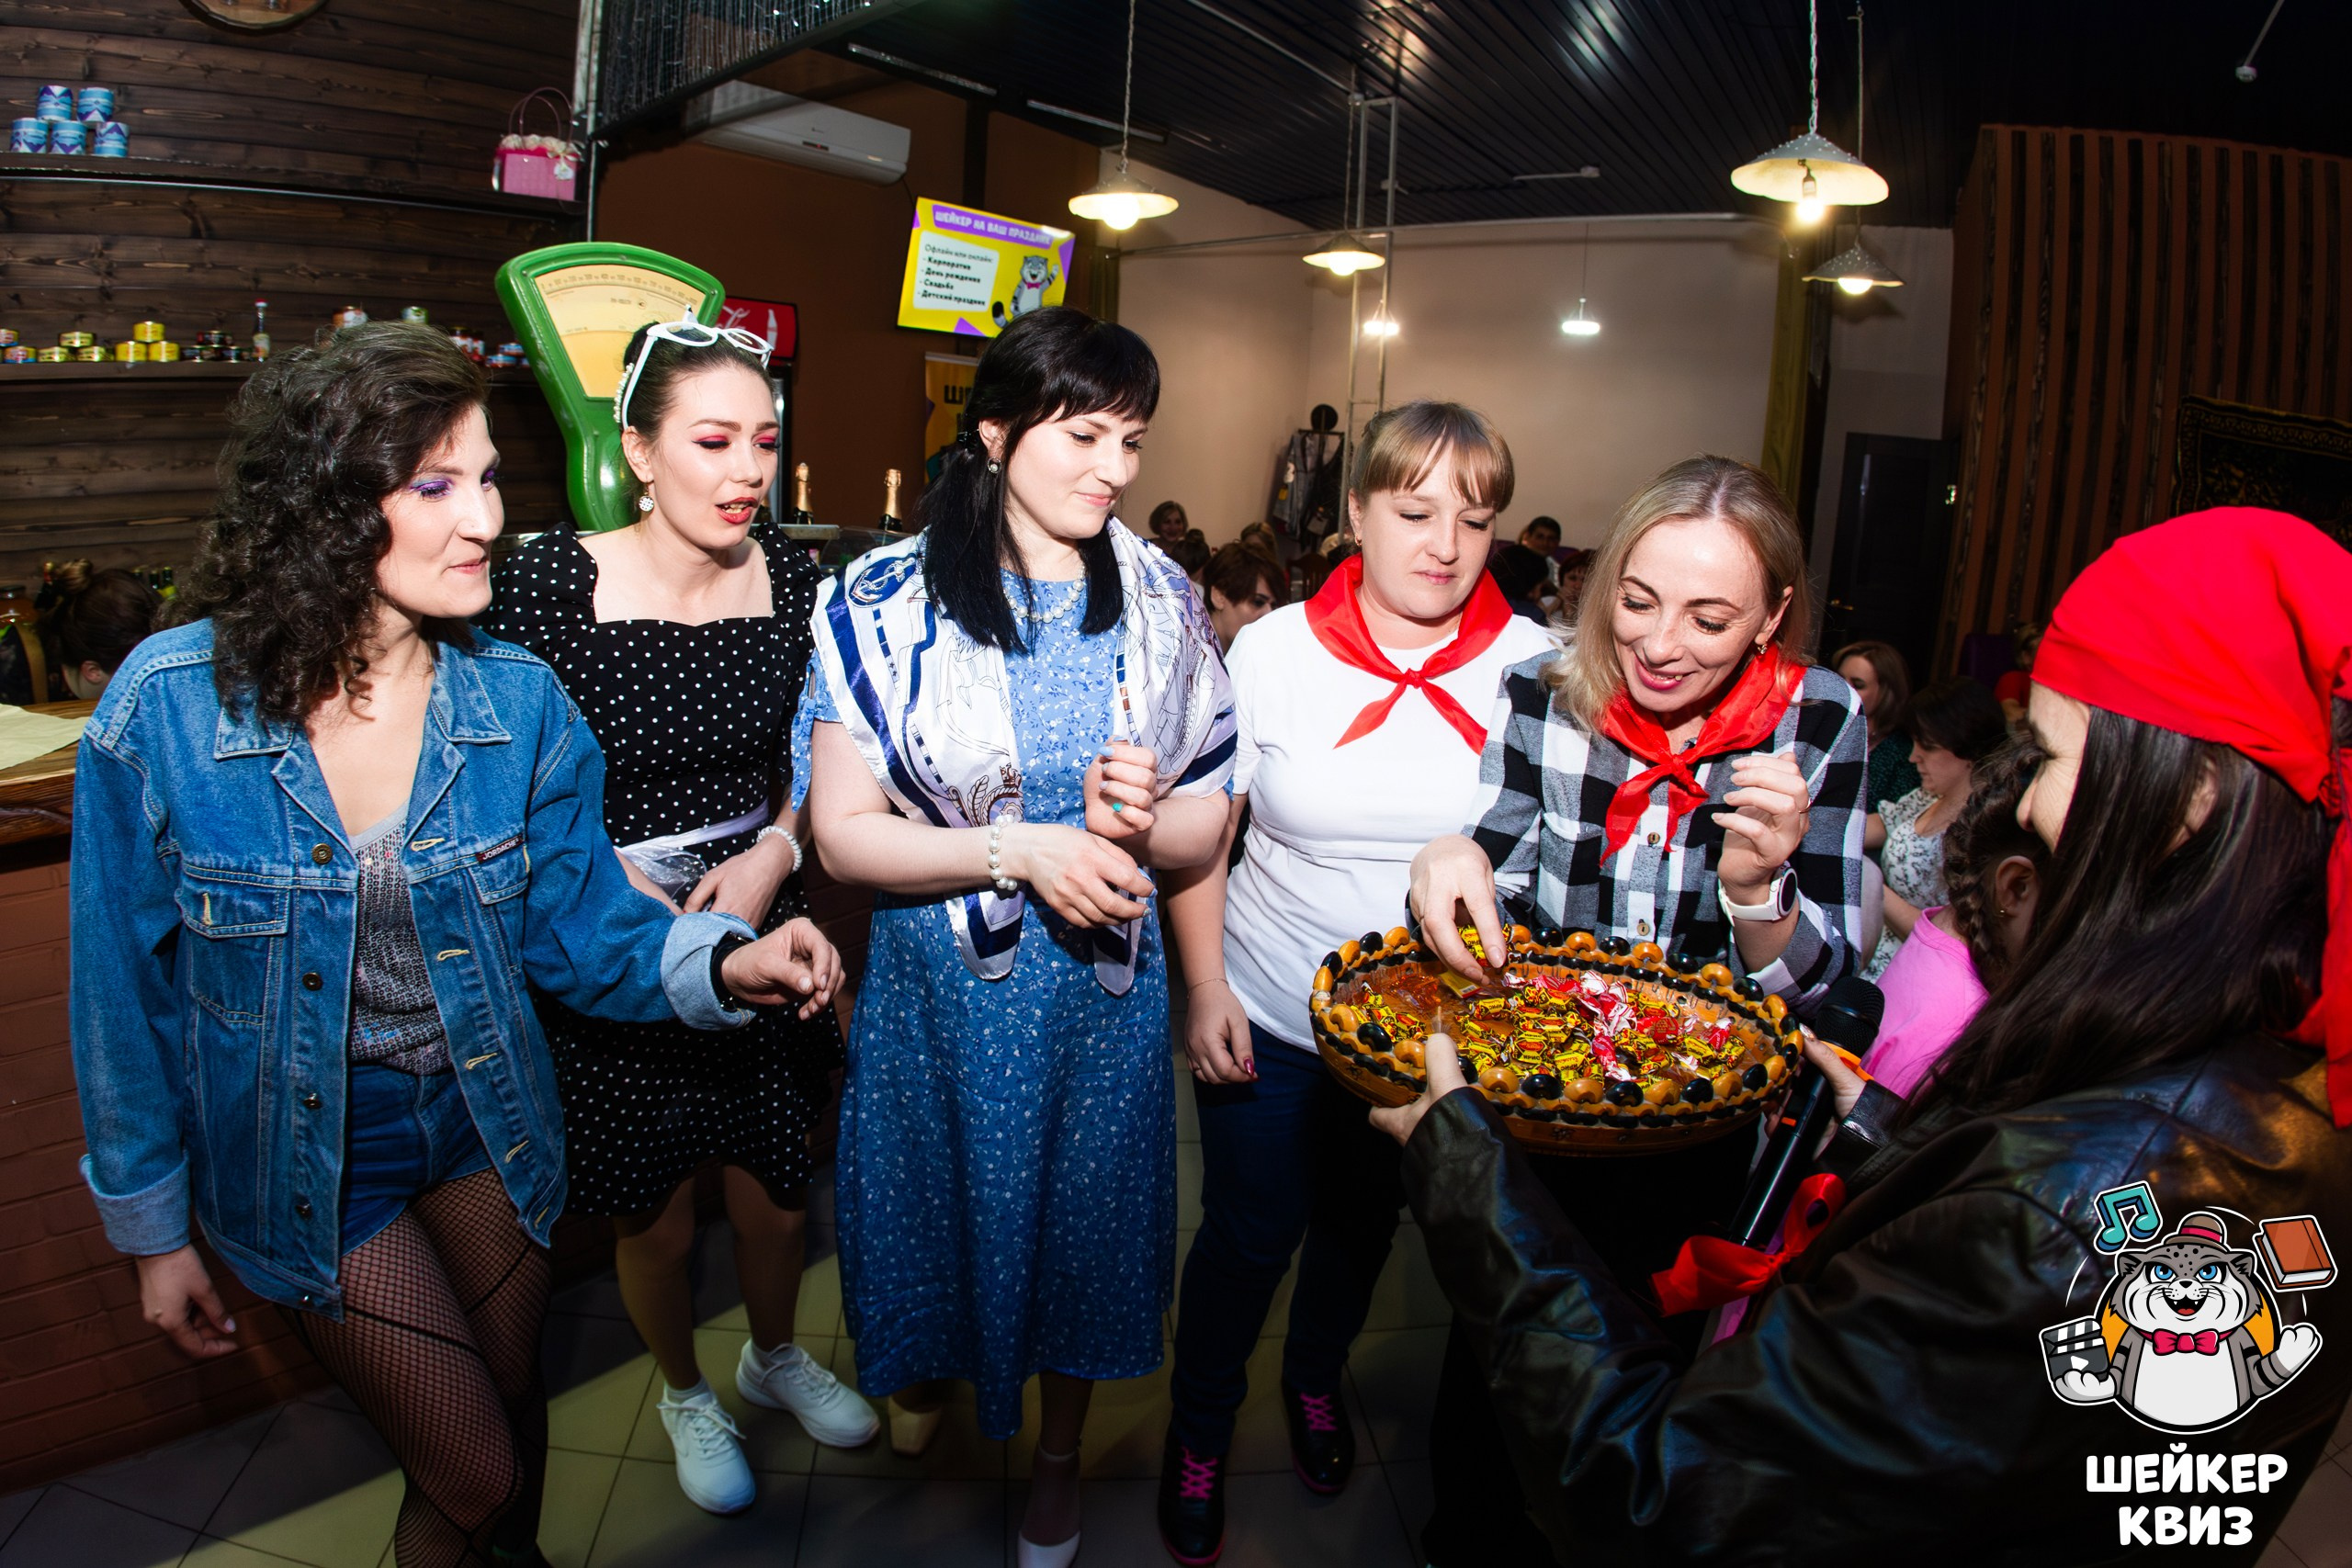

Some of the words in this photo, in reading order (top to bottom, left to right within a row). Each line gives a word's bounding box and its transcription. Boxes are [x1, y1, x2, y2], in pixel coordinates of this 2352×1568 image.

[935, 211, 972, 227] ШЕЙКЕР
[974, 220, 985, 231] НА
[988, 222, 1007, 235] ВАШ
[928, 256, 971, 270] Корпоратив
[925, 267, 944, 276] День
[944, 273, 980, 283] рождения
[924, 278, 954, 289] Свадьба
[922, 289, 953, 300] Детский
[954, 296, 986, 306] праздник
[482, 837, 520, 860] JORDACHE
